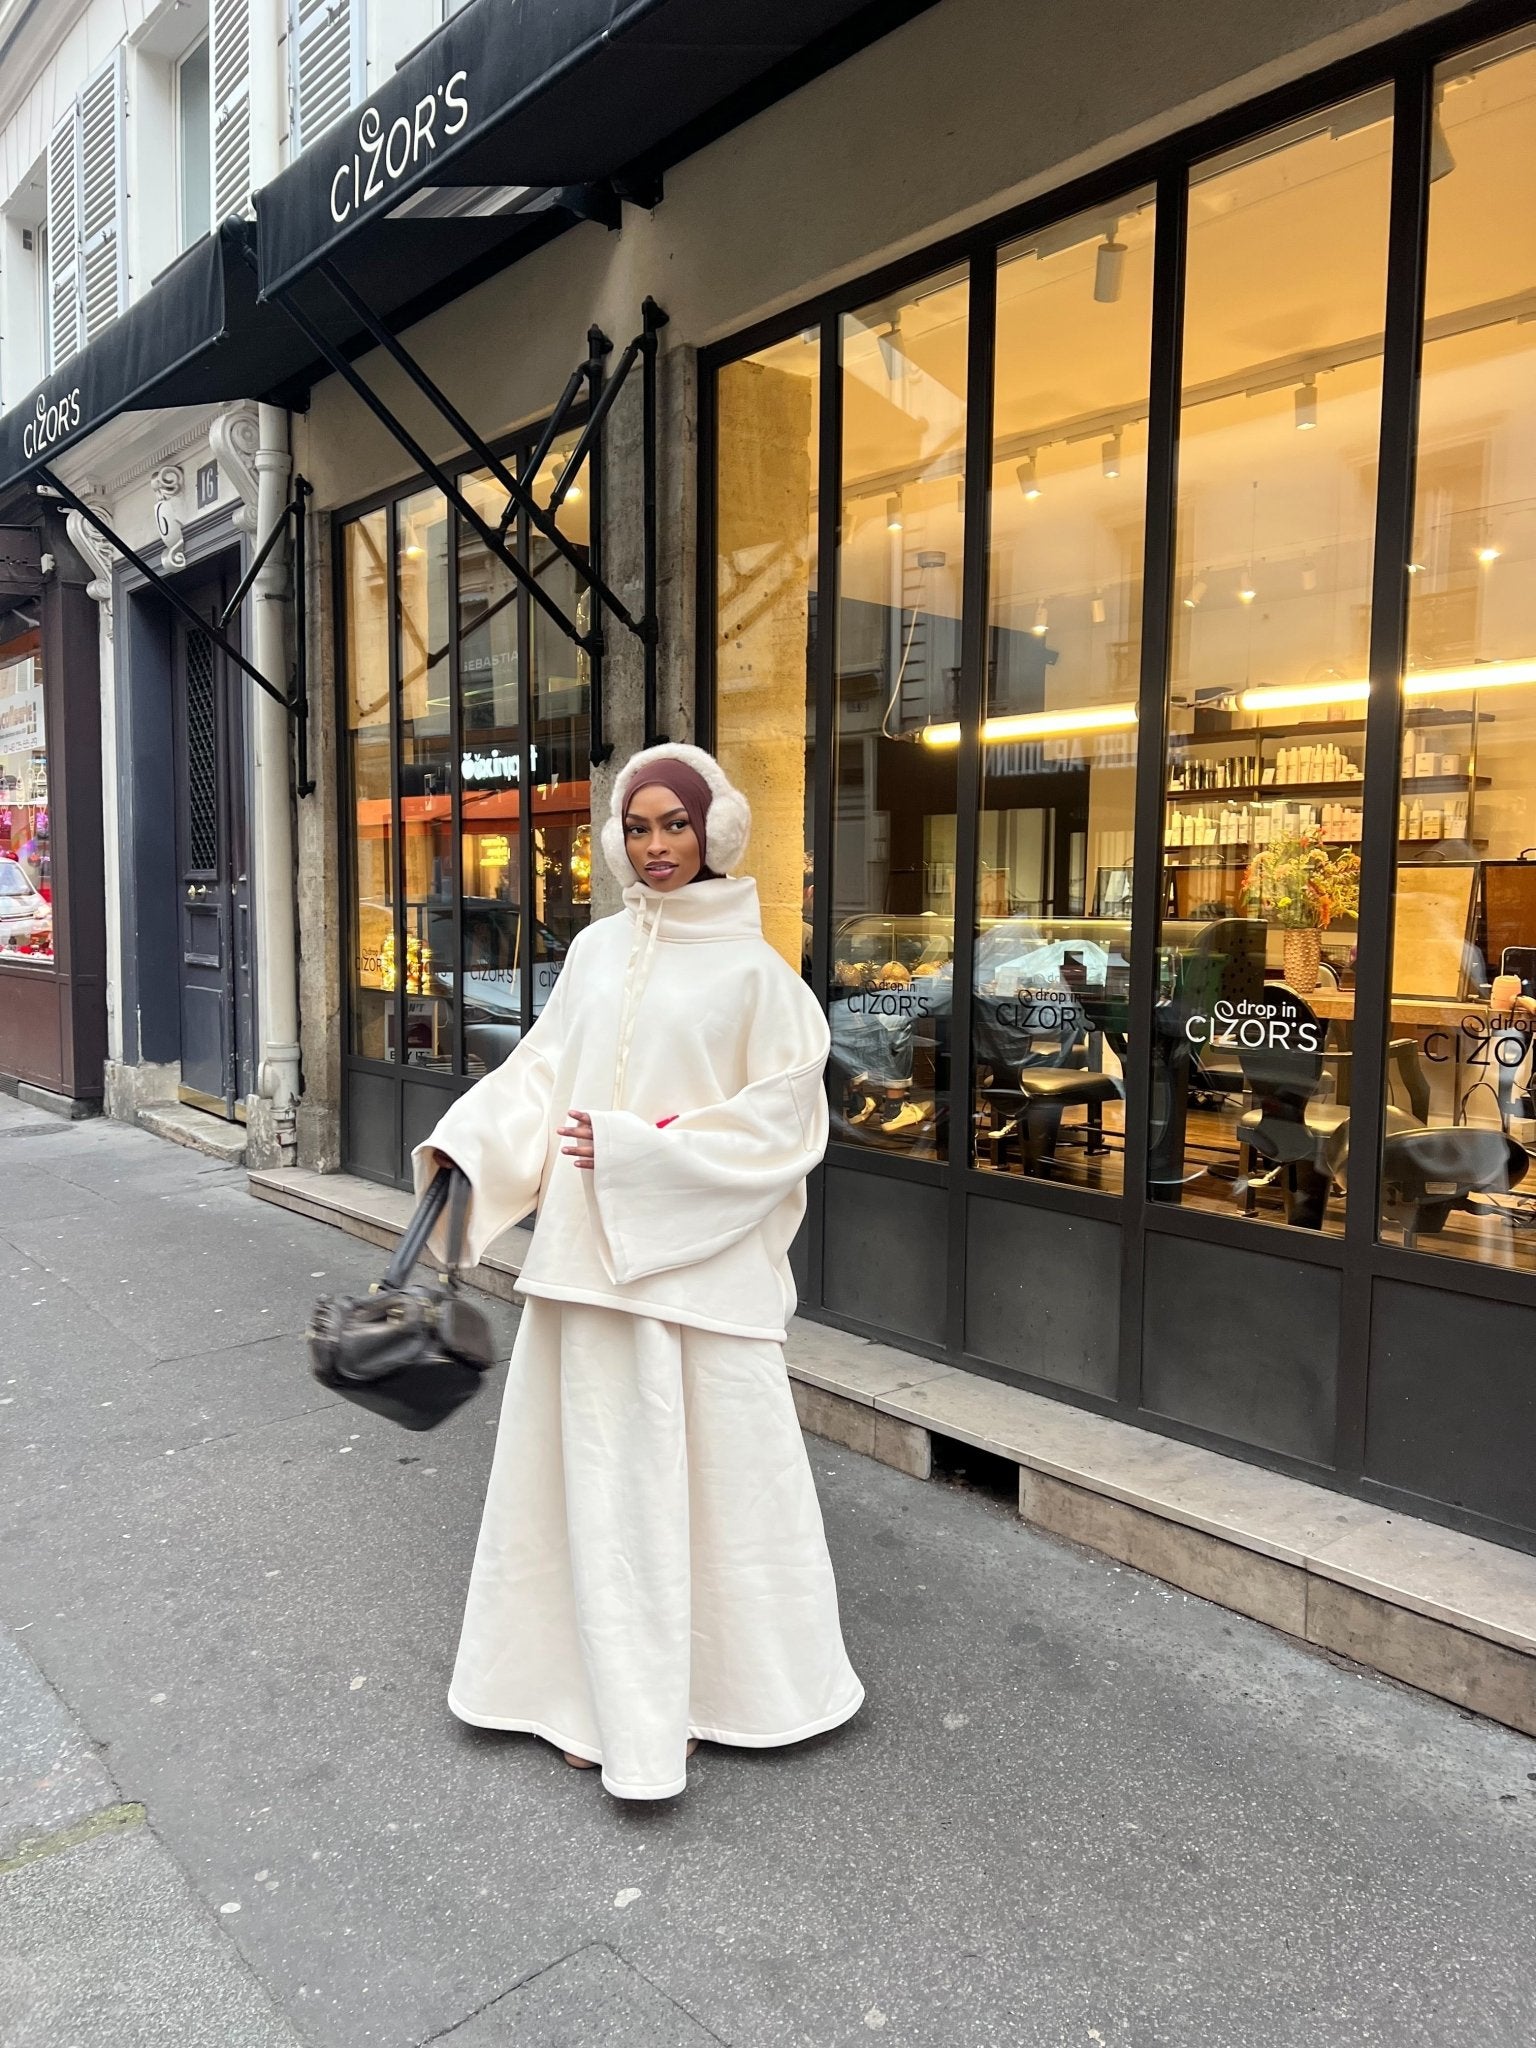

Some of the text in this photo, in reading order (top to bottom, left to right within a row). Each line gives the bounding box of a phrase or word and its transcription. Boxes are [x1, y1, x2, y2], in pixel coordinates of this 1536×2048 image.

[330, 70, 469, 223] CIZOR'S
[23, 388, 80, 459] CIZOR'S
[201, 468, 214, 502] 16
[847, 981, 929, 1018] CIZOR'S
[879, 979, 903, 993] drop
[1035, 988, 1066, 1004] drop
[996, 990, 1096, 1032] CIZOR'S
[1185, 1000, 1319, 1052] CIZOR'S
[1236, 999, 1297, 1020] drop in
[1424, 1015, 1536, 1068] CIZO
